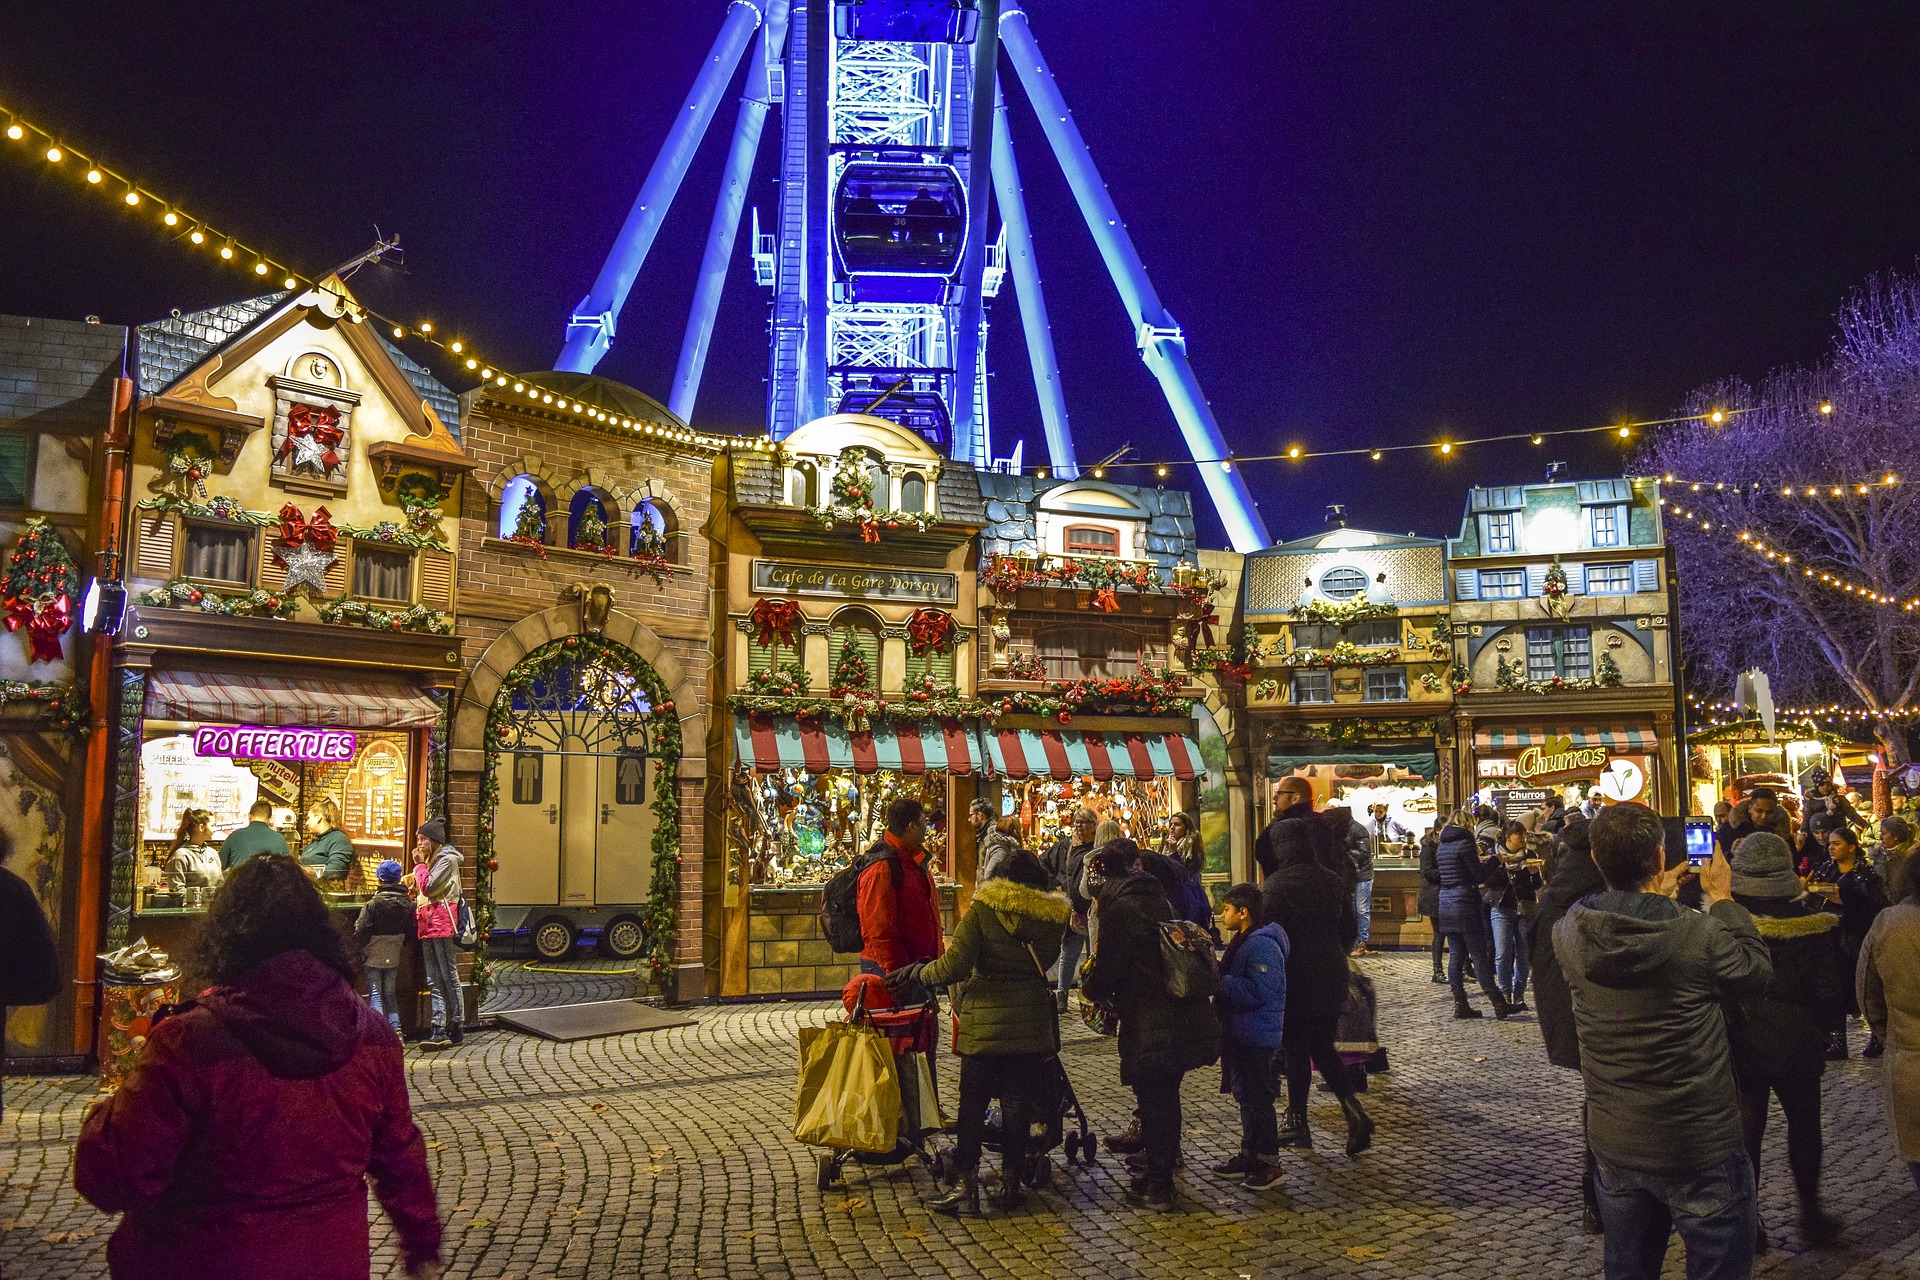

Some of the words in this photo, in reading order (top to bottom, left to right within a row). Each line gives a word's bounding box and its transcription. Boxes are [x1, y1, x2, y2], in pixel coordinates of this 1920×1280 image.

[894, 218, 906, 226] 36
[772, 569, 803, 587] Cafe
[808, 570, 824, 585] de
[828, 573, 847, 586] La
[852, 575, 884, 589] Gare
[889, 577, 940, 595] Dorsay
[198, 731, 354, 758] POFFERTJES
[1517, 747, 1606, 778] Churros
[1508, 790, 1546, 799] Churros
